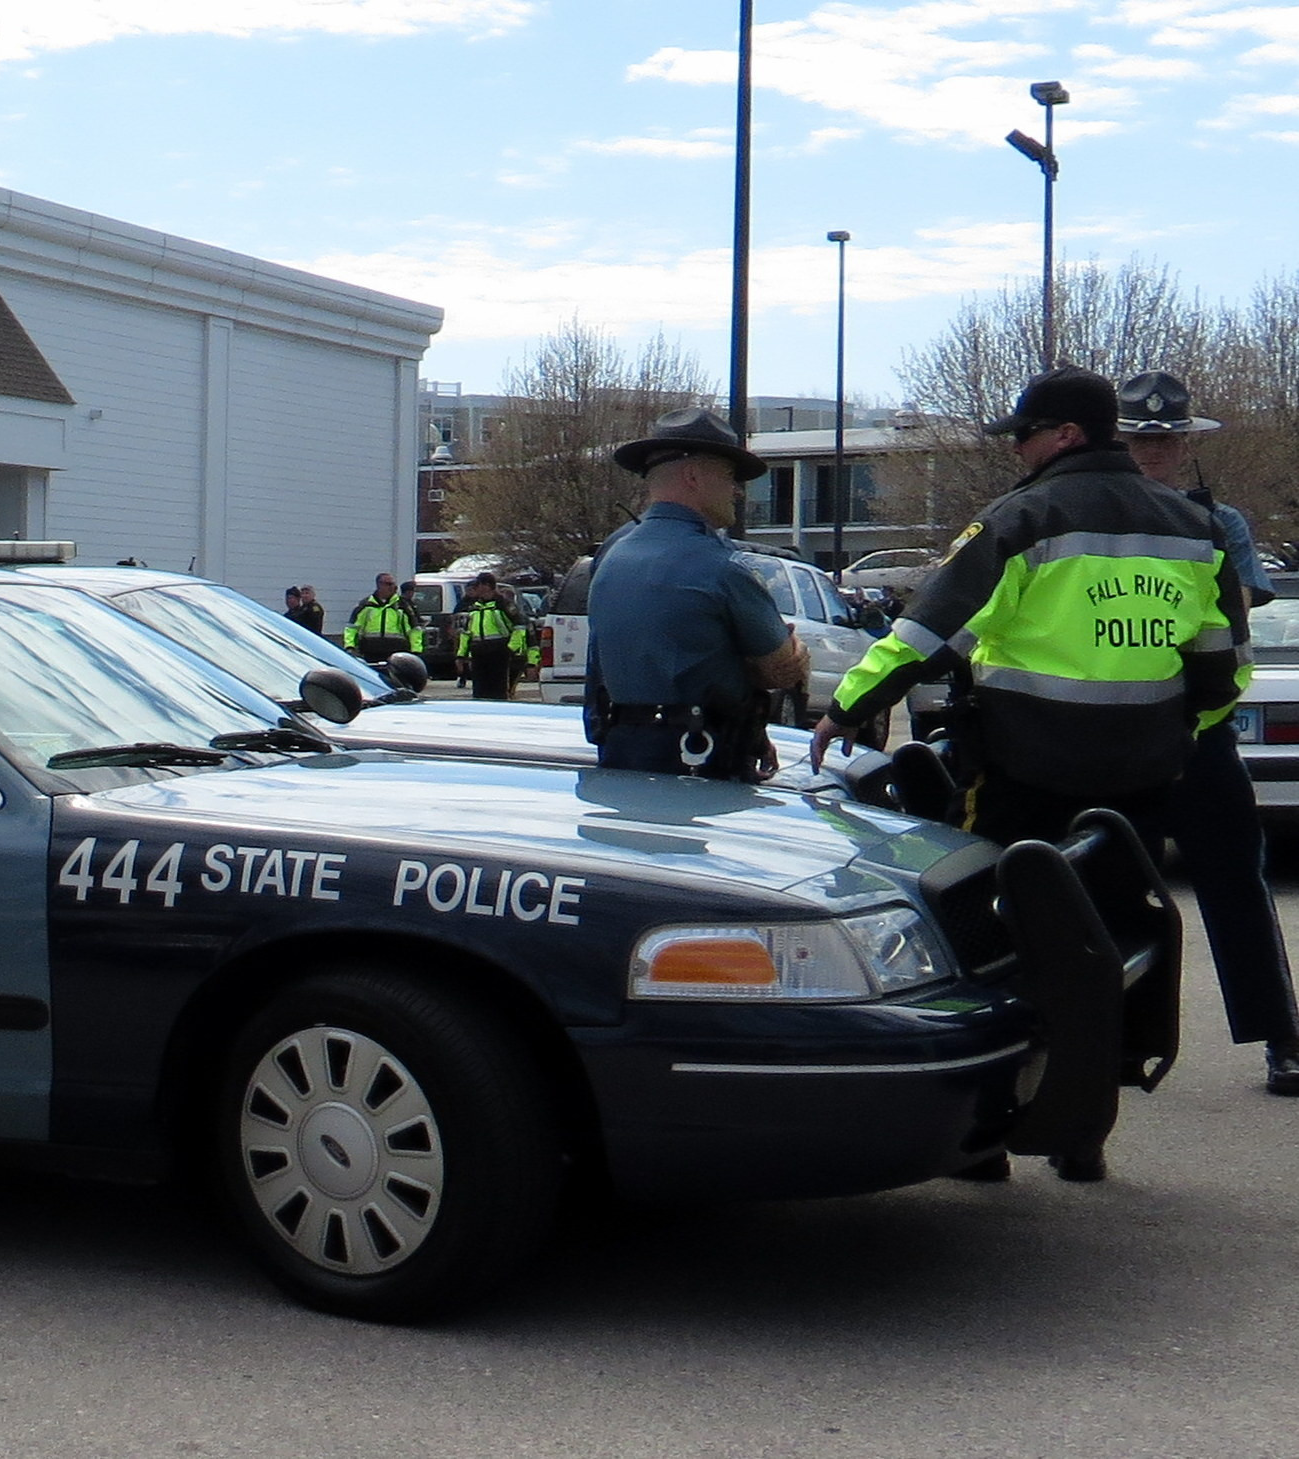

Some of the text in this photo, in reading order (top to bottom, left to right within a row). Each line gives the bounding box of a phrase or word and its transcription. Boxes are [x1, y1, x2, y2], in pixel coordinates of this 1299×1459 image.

[1086, 574, 1184, 609] FALL RIVER
[1095, 618, 1177, 647] POLICE
[58, 837, 586, 925] 444 STATE POLICE
